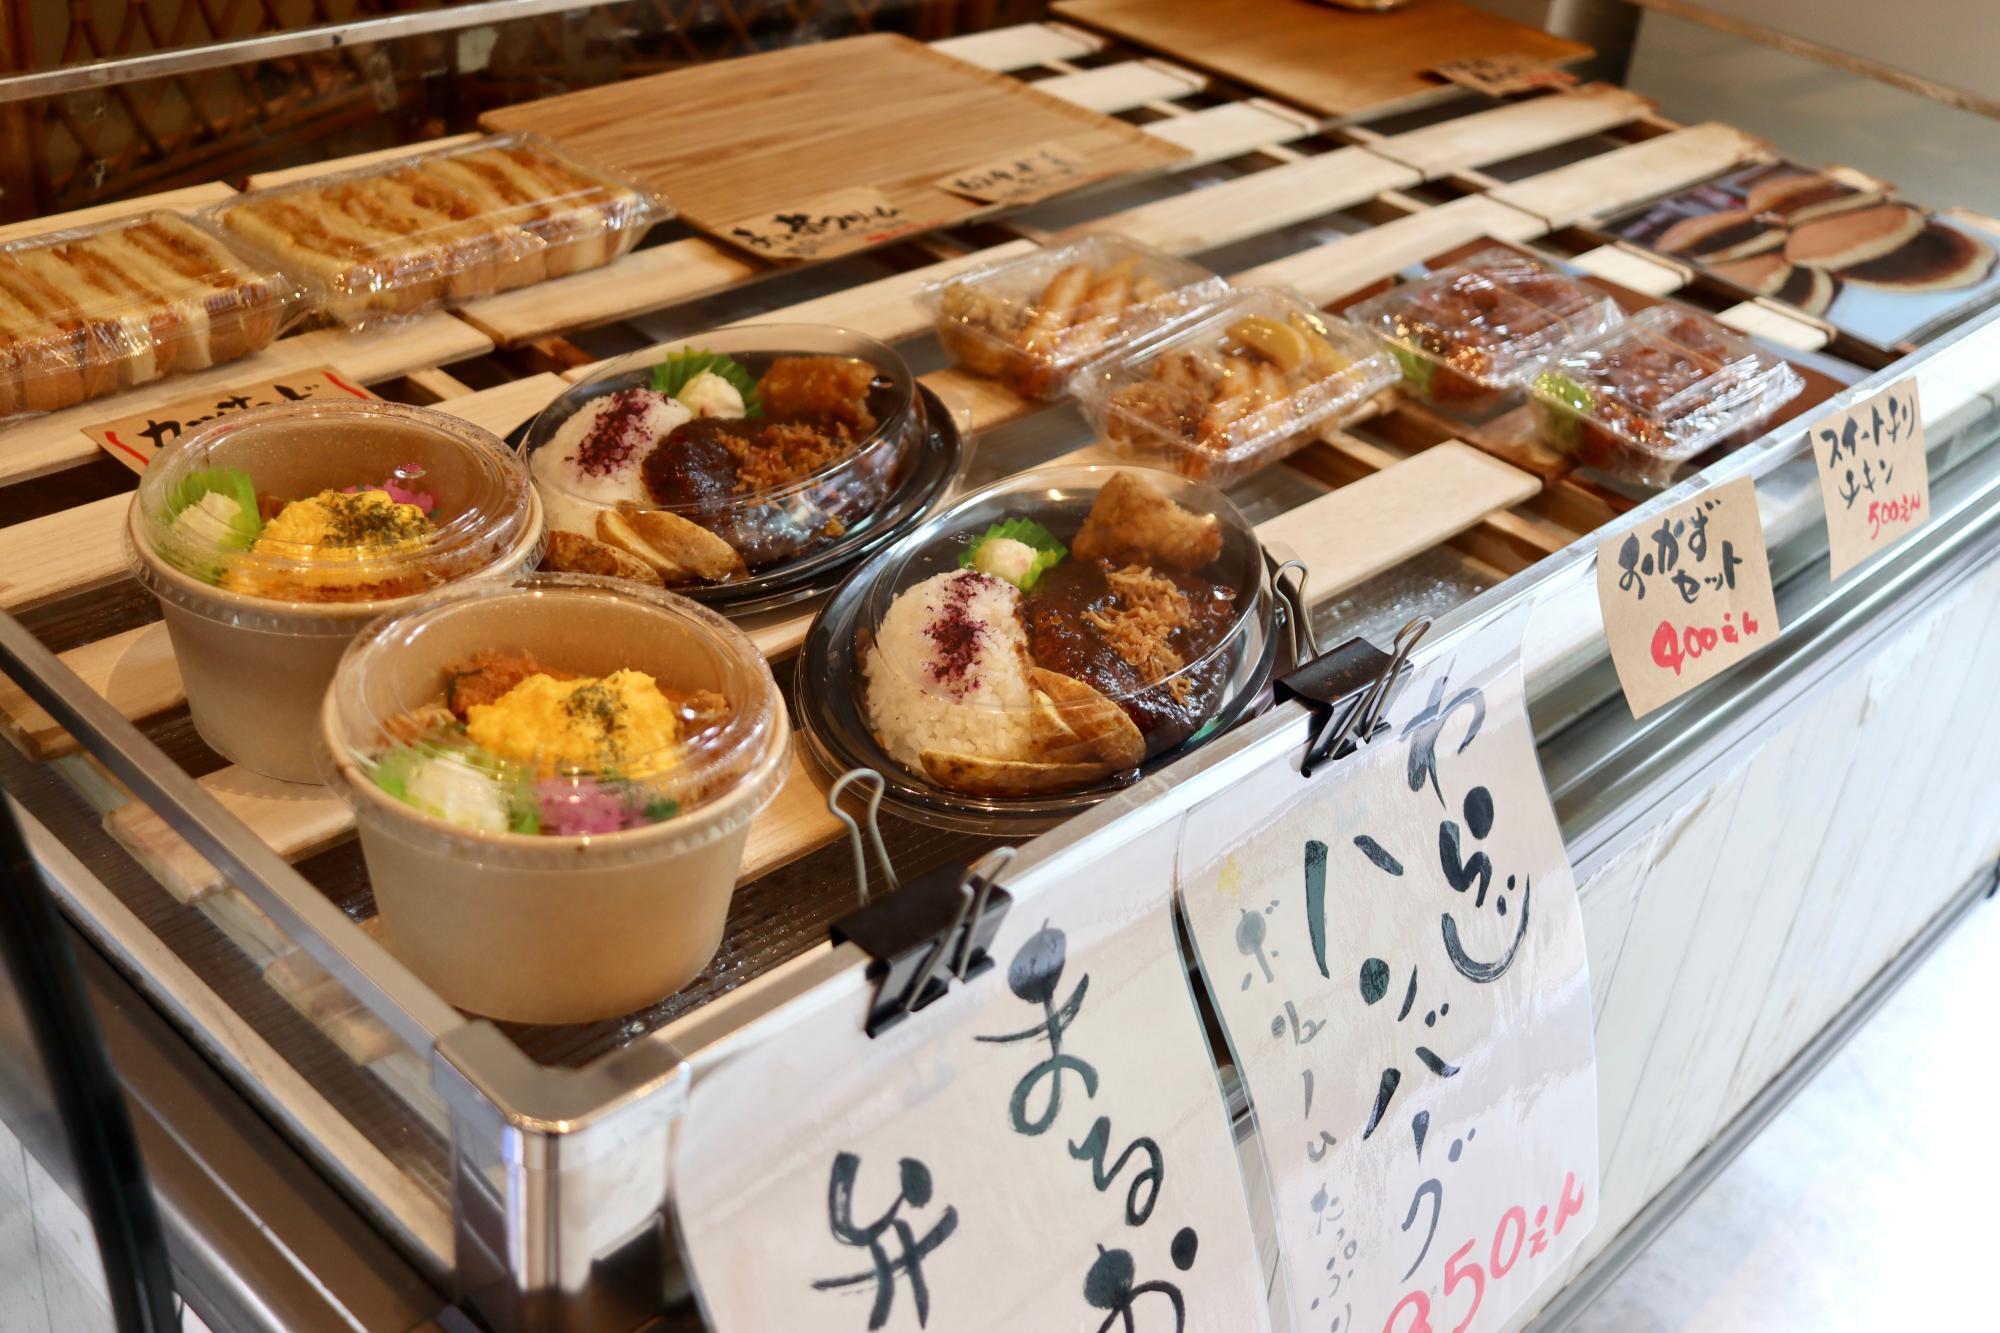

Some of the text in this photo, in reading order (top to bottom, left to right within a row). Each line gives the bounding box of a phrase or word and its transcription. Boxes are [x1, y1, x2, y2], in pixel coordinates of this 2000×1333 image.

[1838, 459, 1894, 509] チキン
[1867, 491, 1921, 540] 500えん
[1618, 498, 1721, 599] おかず
[1671, 540, 1743, 603] セット
[1650, 611, 1759, 676] 400えん
[1304, 834, 1477, 1283] ハンバーグ
[811, 1151, 959, 1332] 弁
